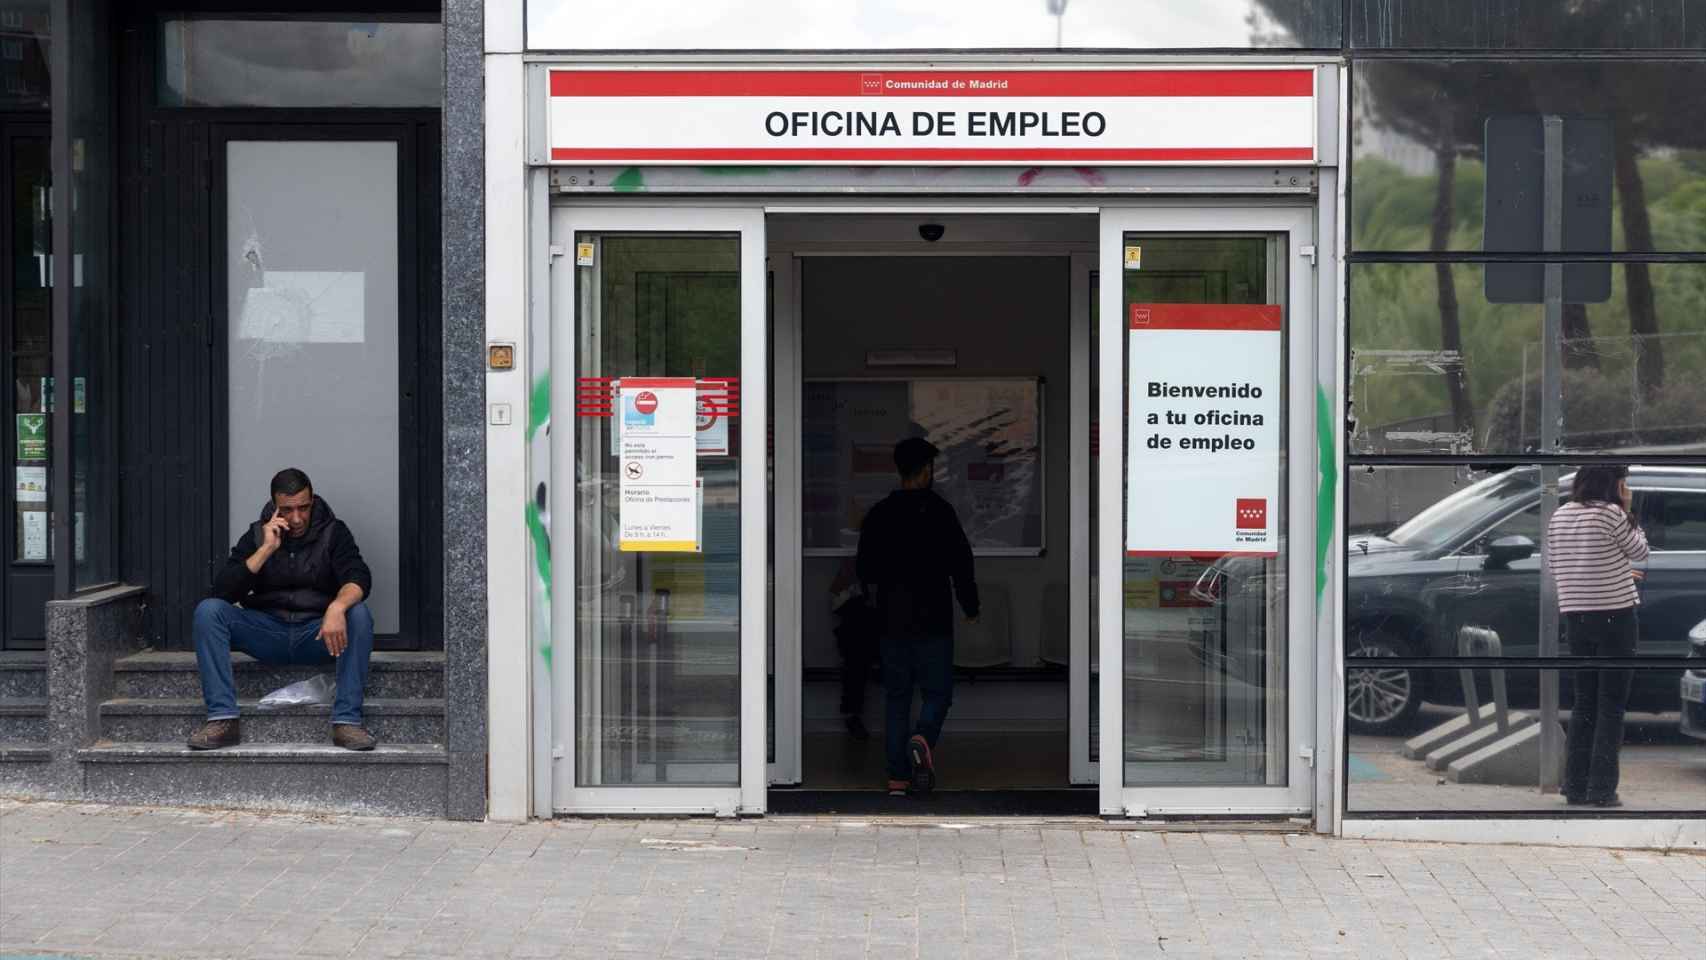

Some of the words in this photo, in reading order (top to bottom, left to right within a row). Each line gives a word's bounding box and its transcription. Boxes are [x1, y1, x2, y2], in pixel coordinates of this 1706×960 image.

[885, 79, 949, 89] Comunidad
[951, 79, 966, 89] de
[969, 79, 1009, 89] Madrid
[765, 111, 902, 137] OFICINA
[911, 111, 957, 137] DE
[967, 111, 1107, 137] EMPLEO
[1147, 382, 1263, 399] Bienvenido
[1147, 412, 1159, 425] a
[1166, 410, 1187, 425] tu
[1193, 410, 1264, 426] oficina
[1147, 433, 1172, 449] de
[1179, 434, 1256, 453] empleo
